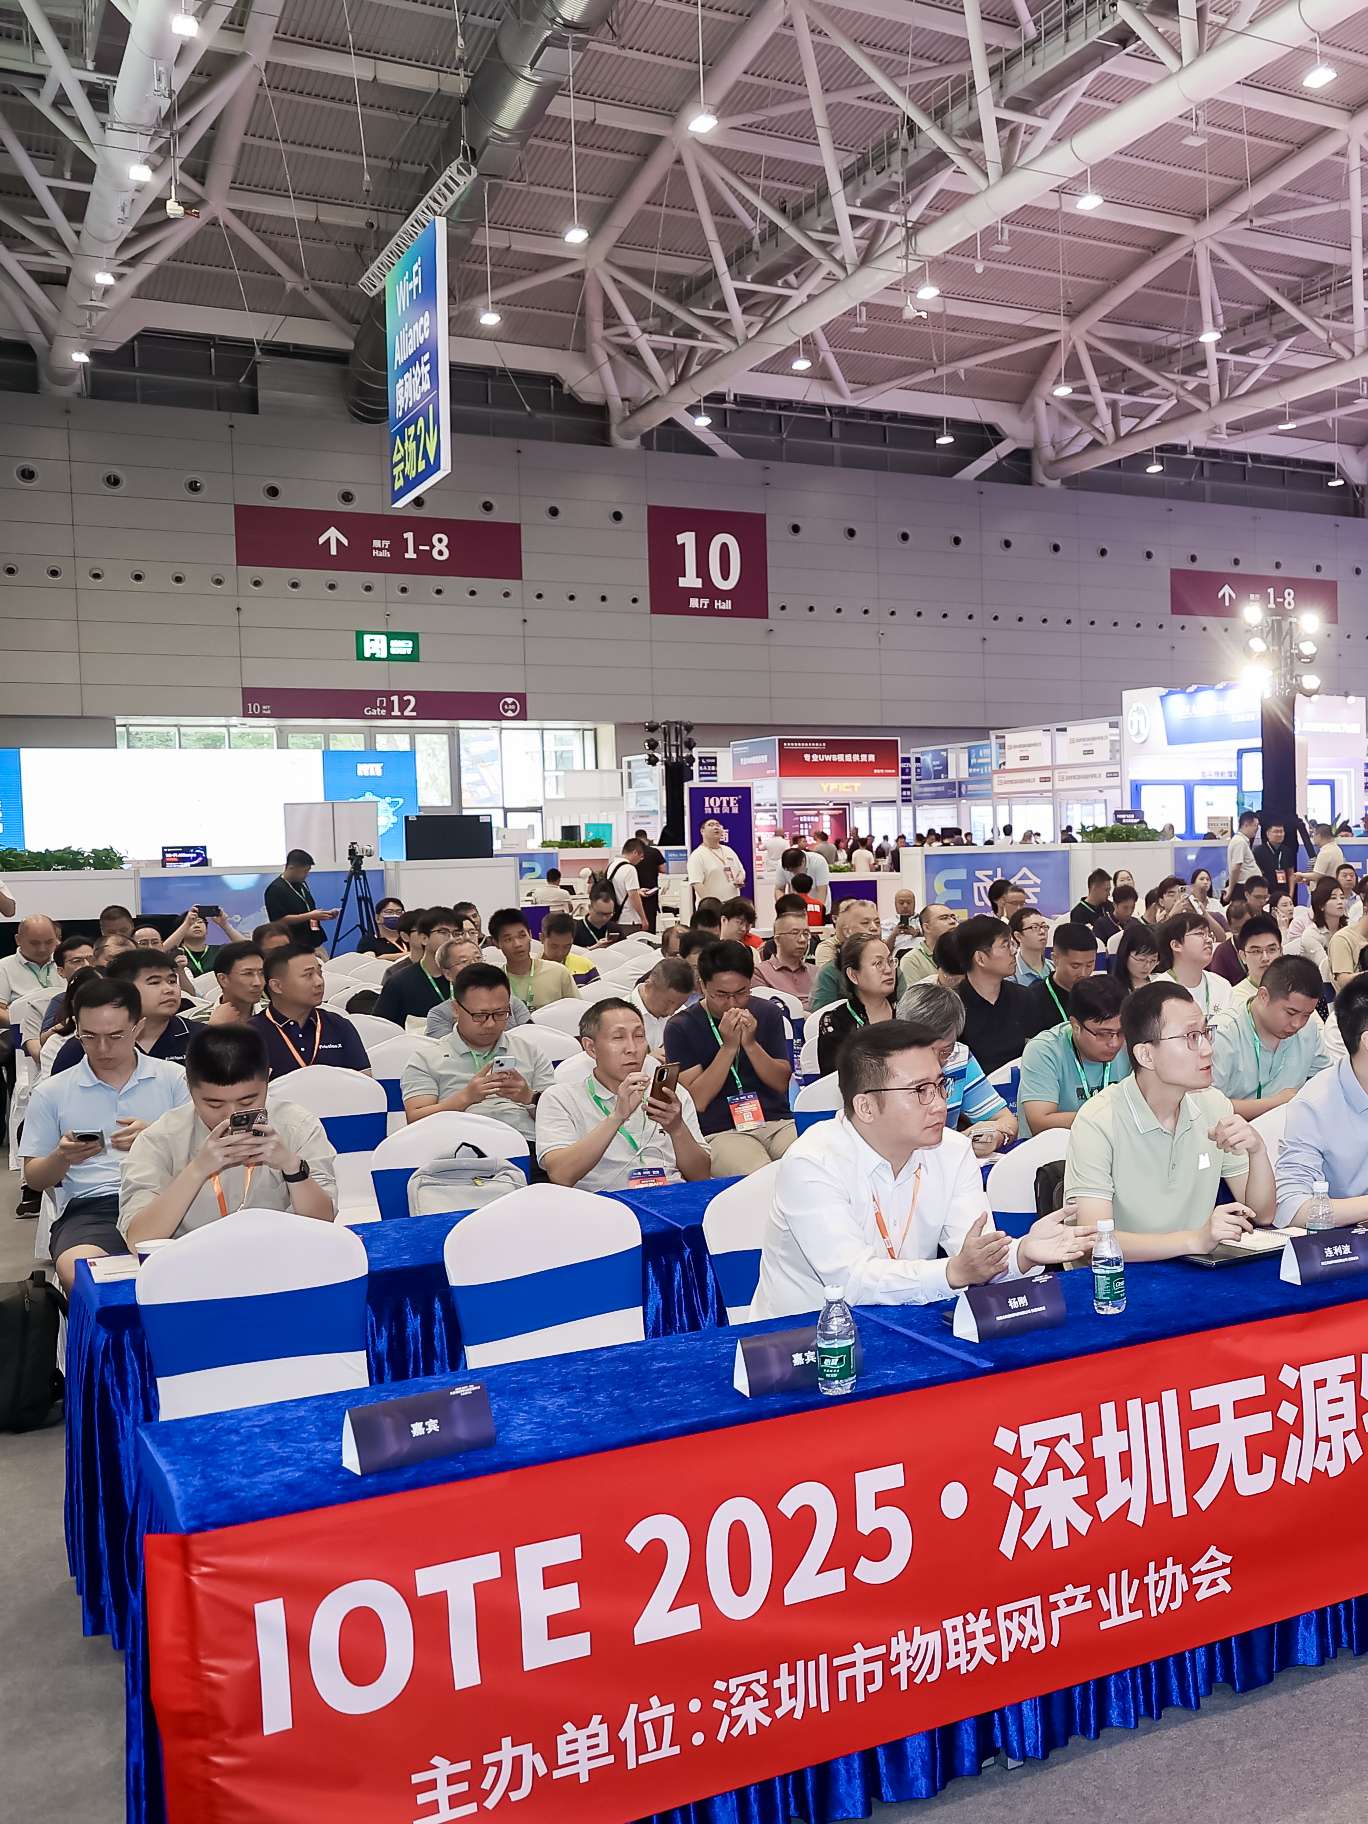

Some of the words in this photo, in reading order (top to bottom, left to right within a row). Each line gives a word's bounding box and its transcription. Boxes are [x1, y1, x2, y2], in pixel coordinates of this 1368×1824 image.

[396, 256, 421, 316] Wi-Fi
[394, 310, 430, 370] Alliance
[395, 352, 431, 419] 序列论坛
[392, 416, 425, 491] 会场2
[372, 549, 391, 558] Halls
[403, 532, 450, 561] 1-8
[676, 531, 741, 590] 10
[688, 597, 709, 609] 展厅
[714, 599, 732, 610] Hall
[1266, 587, 1296, 610] 1-8
[247, 703, 261, 714] 10
[363, 706, 387, 716] Gate
[390, 695, 417, 716] 12
[704, 796, 739, 808] IOTE
[791, 1350, 817, 1367] 嘉宾
[410, 1418, 440, 1438] 嘉宾
[253, 1533, 591, 1736] IOTE
